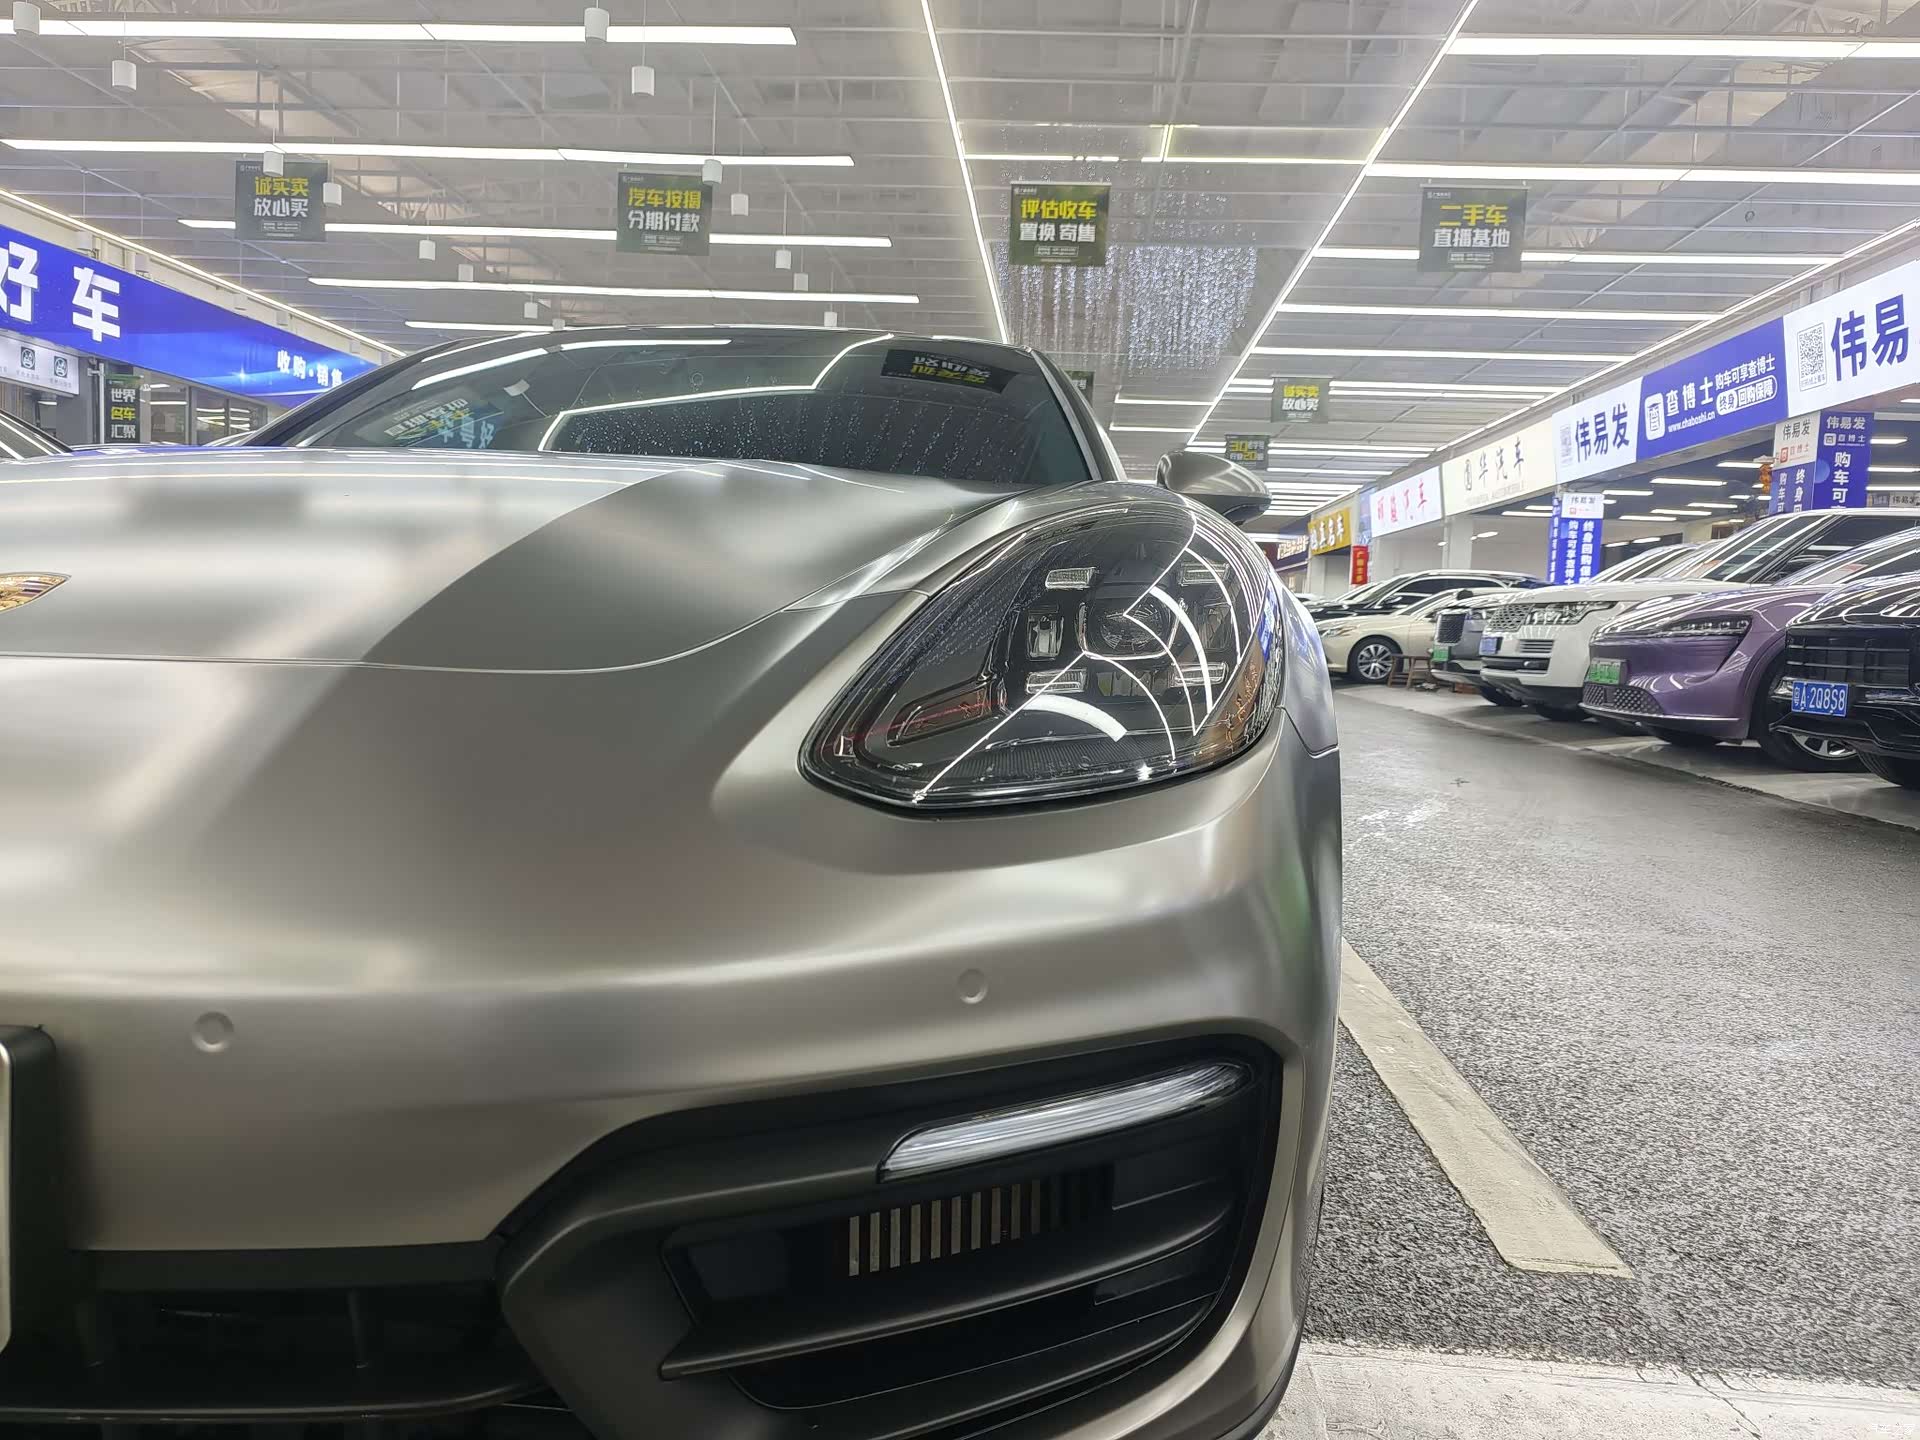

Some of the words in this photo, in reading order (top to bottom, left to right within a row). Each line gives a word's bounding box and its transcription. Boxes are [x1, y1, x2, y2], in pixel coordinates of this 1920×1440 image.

[254, 176, 309, 196] 诚实卖
[253, 198, 309, 217] 放心买
[627, 187, 701, 209] 汽车按揭
[1021, 199, 1097, 219] 评估收车
[627, 209, 700, 232] 分期付款
[1439, 204, 1508, 226] 二手车
[1019, 222, 1056, 241] 置换
[1059, 223, 1096, 242] 寄售
[1432, 228, 1511, 247] 直播基地
[0, 241, 120, 342] 好车
[1830, 293, 1909, 382] 伟易
[1715, 353, 1775, 390] 购车可享查博士
[111, 388, 136, 403] 世界
[1666, 376, 1714, 416] 查博士
[111, 424, 136, 439] 汇聚
[1668, 410, 1715, 432] www.chaboshi.cn
[1783, 419, 1811, 440] 伟易发
[1826, 416, 1866, 430] 伟易发
[1575, 402, 1629, 463] 伟易发
[1830, 451, 1851, 508] 购车可
